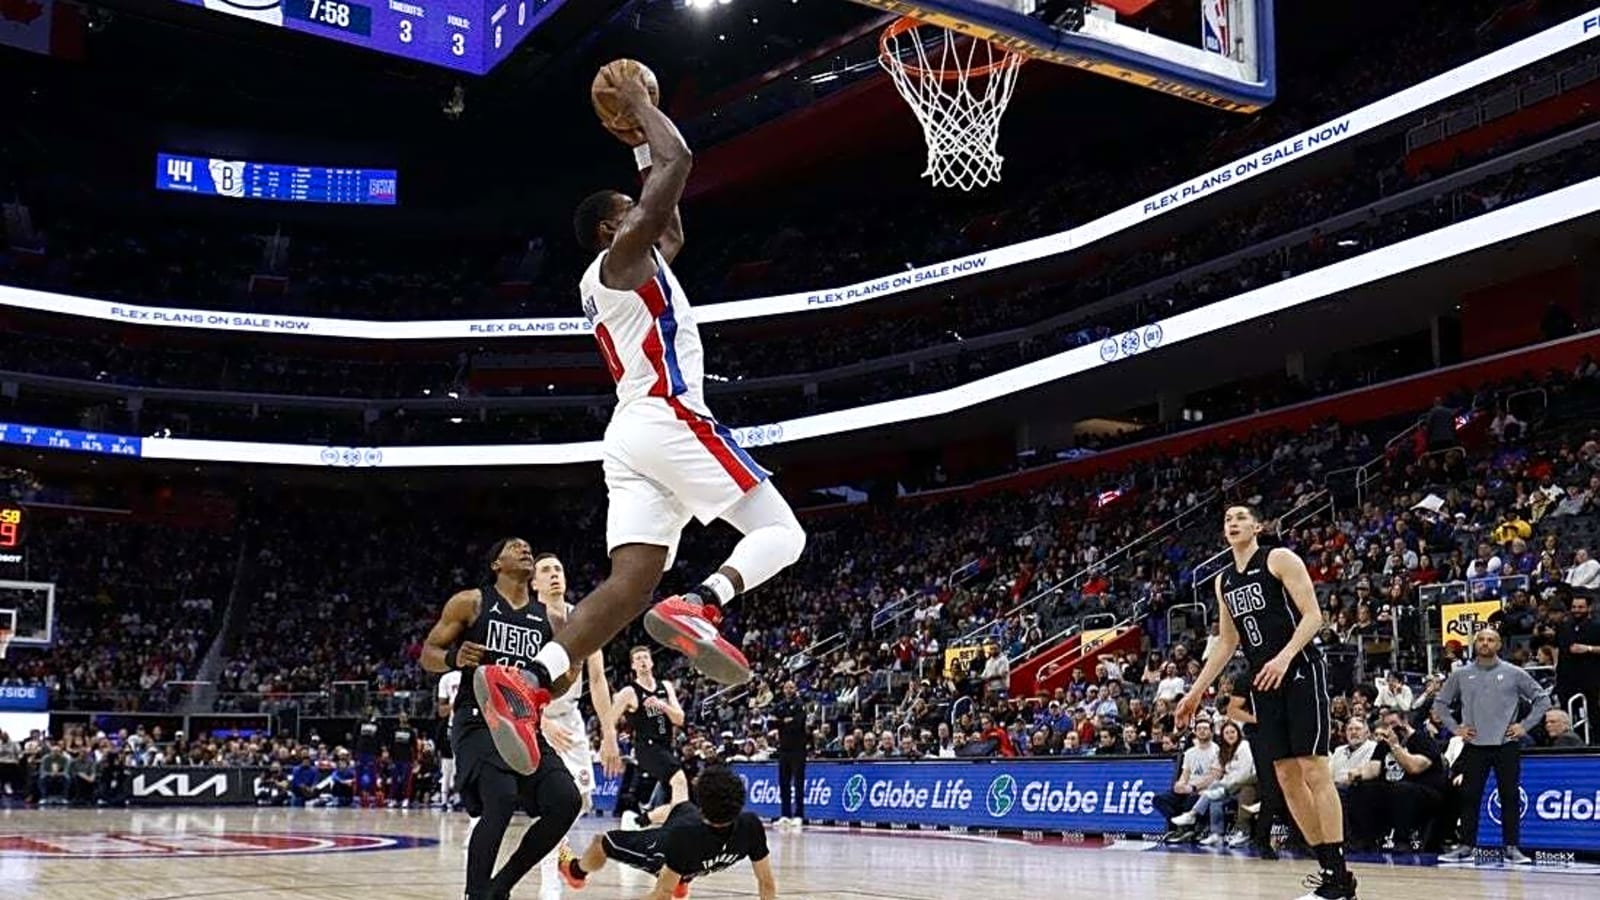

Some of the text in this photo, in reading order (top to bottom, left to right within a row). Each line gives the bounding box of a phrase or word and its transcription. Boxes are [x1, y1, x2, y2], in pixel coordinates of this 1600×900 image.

[309, 0, 350, 27] 7:58
[399, 20, 412, 43] 3
[452, 33, 465, 56] 3
[167, 159, 193, 183] 44
[222, 166, 233, 190] B
[1143, 120, 1350, 214] FLEX PLANS ON SALE NOW
[807, 257, 987, 305] FLEX PLANS ON SALE NOW
[110, 307, 310, 329] FLEX PLANS ON SALE NOW
[470, 324, 505, 333] FLEX
[508, 322, 555, 331] PLANS
[558, 321, 579, 330] ON
[1224, 582, 1266, 618] NETS
[486, 619, 542, 661] NETS
[1243, 615, 1263, 647] 8
[869, 779, 973, 810] Globe Life
[1021, 779, 1155, 815] Globe Life
[1535, 850, 1576, 861] StockX
